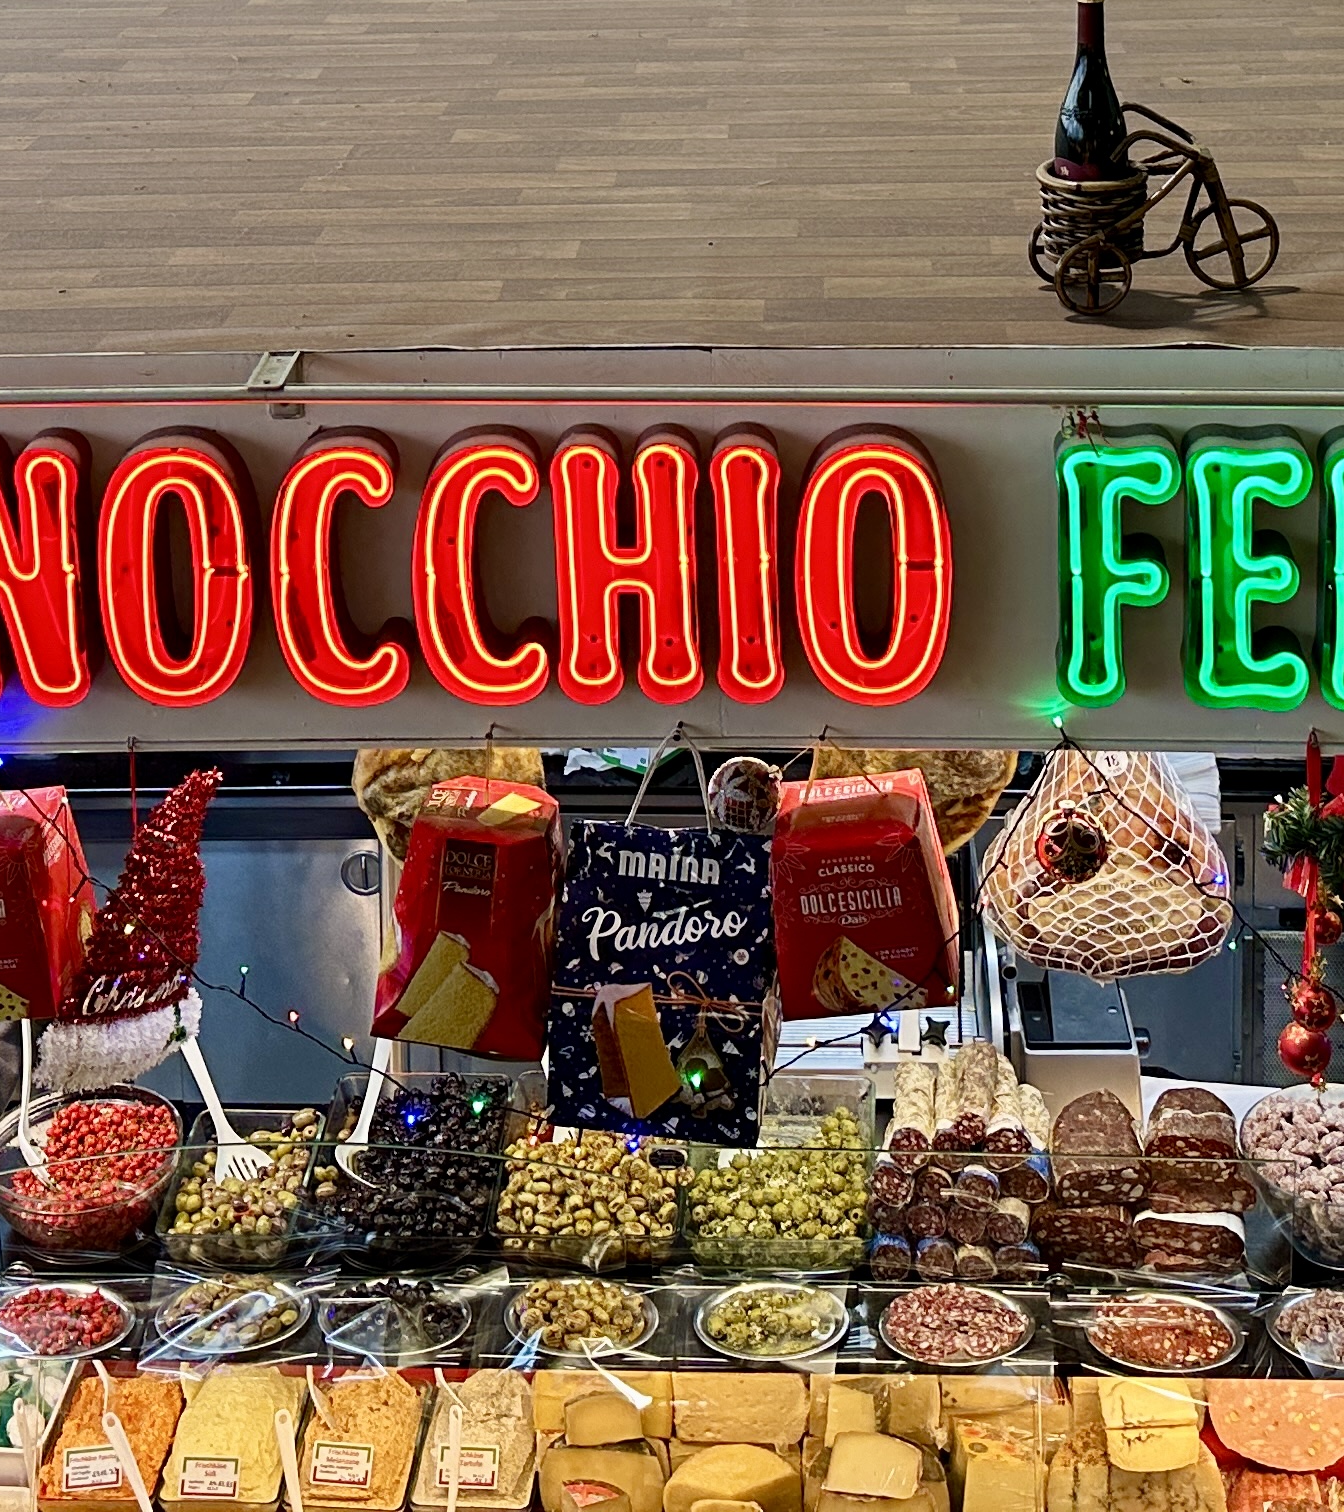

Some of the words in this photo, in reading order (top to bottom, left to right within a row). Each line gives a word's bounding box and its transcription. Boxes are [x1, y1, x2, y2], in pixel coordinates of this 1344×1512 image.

[445, 850, 492, 867] DOLCE
[617, 849, 720, 886] MAINA
[817, 863, 875, 877] CLASSICO
[441, 880, 492, 897] Pandoro
[799, 886, 903, 916] DOLCESICILIA
[581, 902, 748, 962] Pandoro
